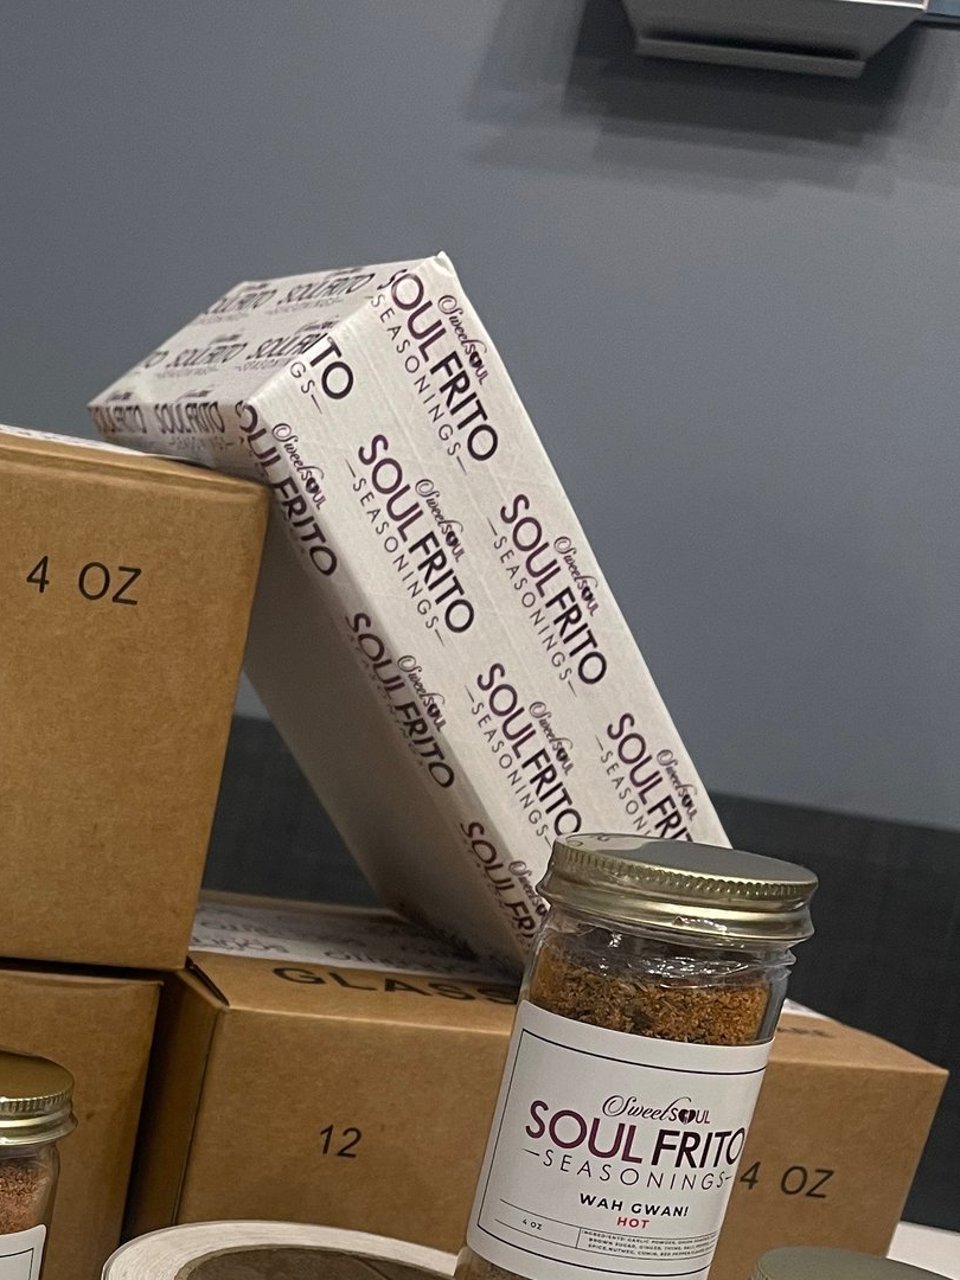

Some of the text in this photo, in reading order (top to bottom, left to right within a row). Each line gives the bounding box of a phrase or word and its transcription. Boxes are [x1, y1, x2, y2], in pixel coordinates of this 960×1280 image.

[430, 350, 499, 463] FRITO
[271, 477, 338, 577] FRITO
[352, 476, 441, 630] SEASONINGS
[358, 434, 475, 634] SOUL FRITO
[25, 555, 142, 606] 4 OZ
[493, 534, 574, 684] SEASONINGS
[499, 493, 608, 686] SOUL FRITO
[345, 611, 455, 789] SOUL FRITO
[476, 662, 583, 836] SOUL FRITO
[606, 712, 663, 804] SOUL
[460, 820, 516, 898] SOUL
[318, 1124, 363, 1159] 12
[524, 1100, 747, 1169] SOUL FRITO
[542, 1148, 726, 1191] SEASONINGS
[579, 1193, 690, 1218] WAH GWAN!
[740, 1161, 835, 1199] 4 OZ
[530, 1221, 544, 1231] OZ
[616, 1216, 651, 1230] HOT
